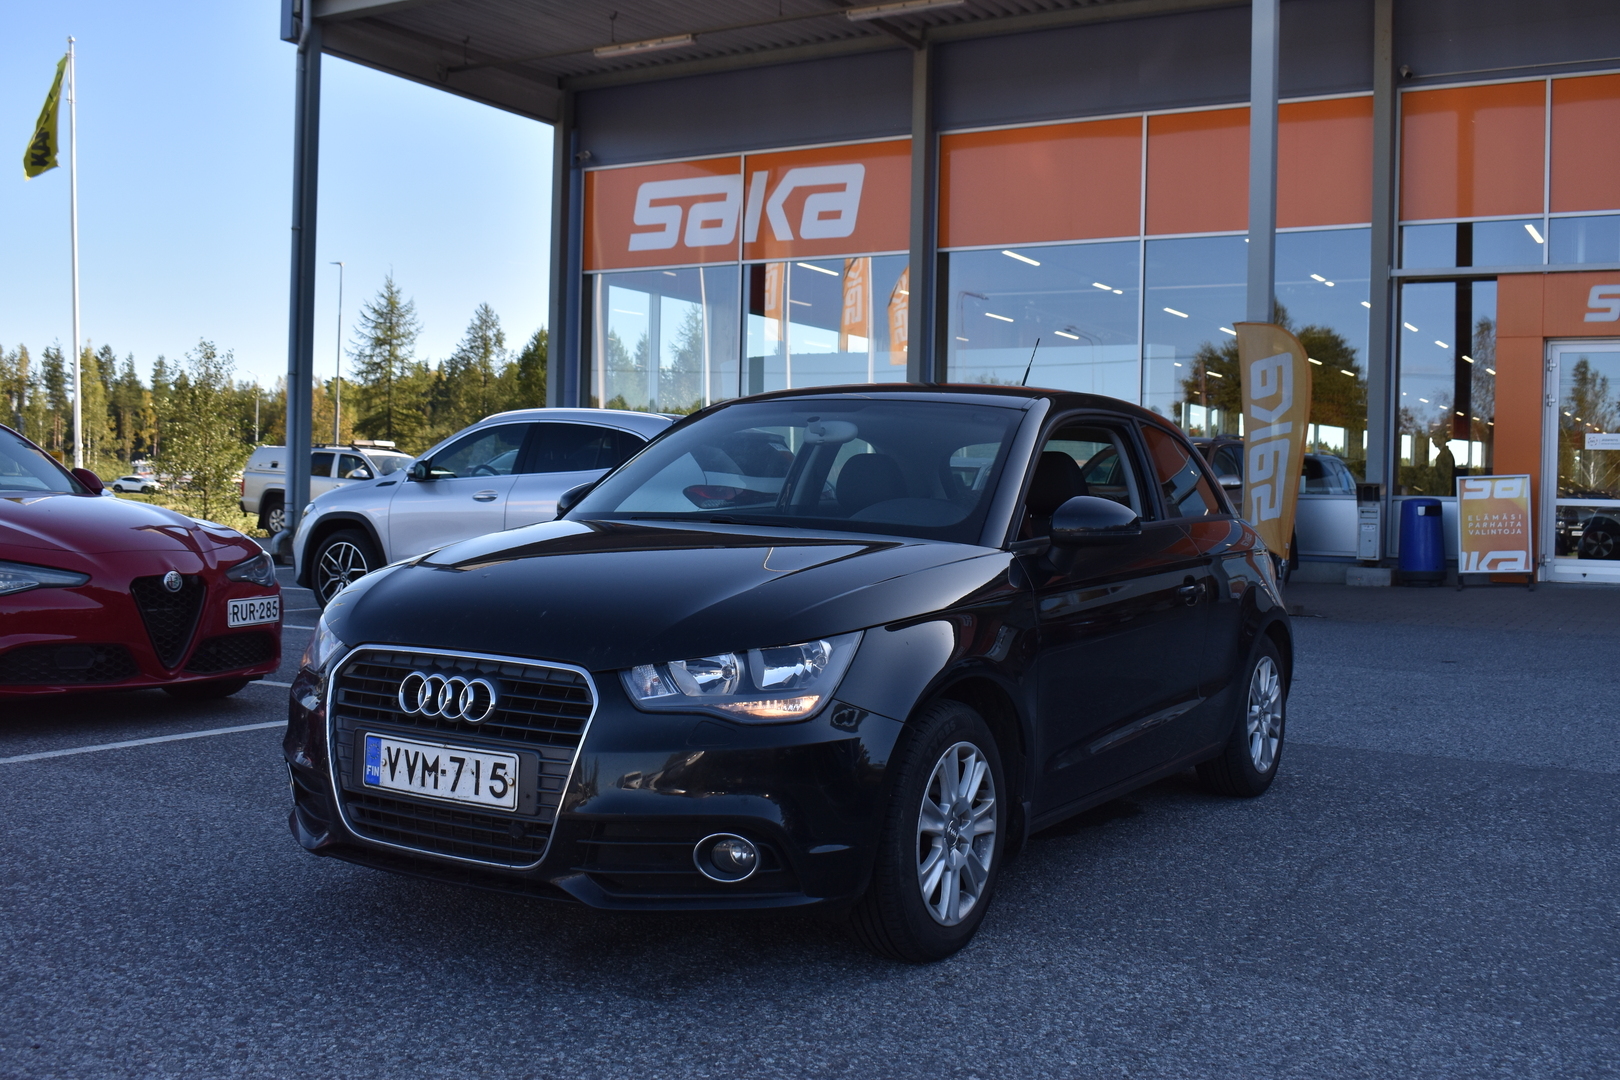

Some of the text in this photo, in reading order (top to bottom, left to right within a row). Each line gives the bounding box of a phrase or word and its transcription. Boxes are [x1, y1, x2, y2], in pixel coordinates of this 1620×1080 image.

[1467, 513, 1522, 522] ELÄMÄSI
[1467, 521, 1522, 529] PARHAITA
[1468, 528, 1522, 536] VALINTOJA
[232, 600, 278, 622] RUR-285
[366, 764, 380, 777] FIN
[386, 746, 508, 799] VVM-715
